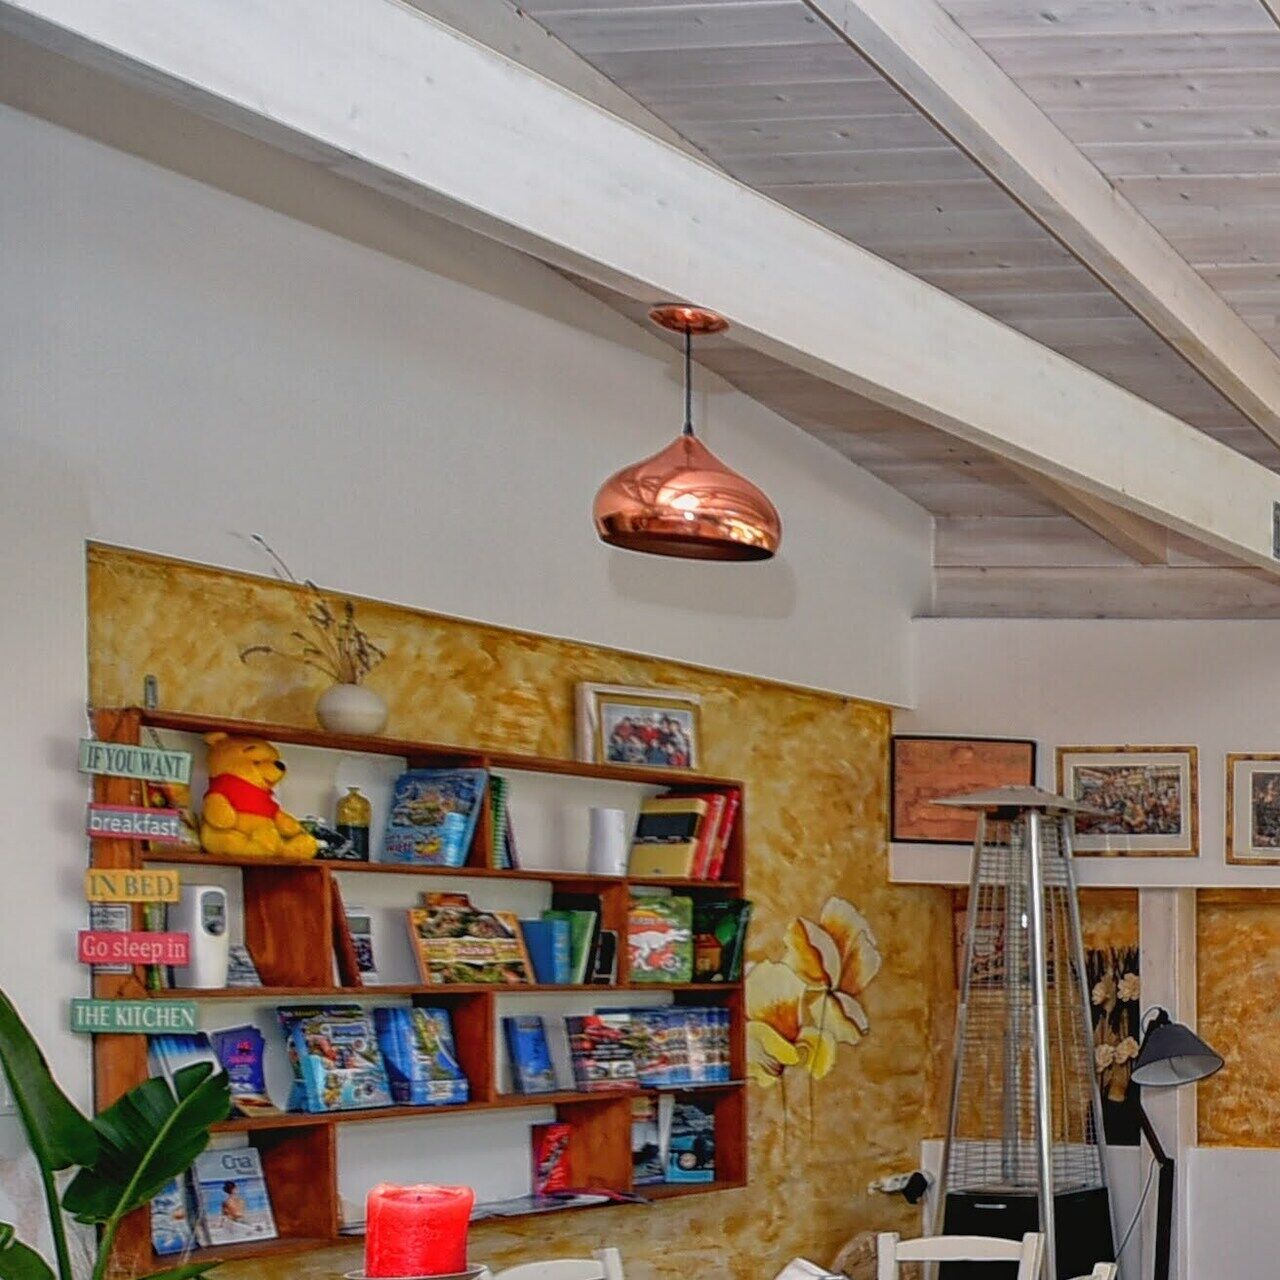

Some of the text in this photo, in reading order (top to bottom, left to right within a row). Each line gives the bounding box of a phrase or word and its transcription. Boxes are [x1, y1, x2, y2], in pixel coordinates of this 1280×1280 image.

[86, 745, 184, 779] IF YOU WANT
[90, 809, 178, 837] breakfast
[91, 875, 173, 897] IN BED
[82, 935, 187, 963] Go sleep in
[75, 1005, 196, 1028] THE KITCHEN
